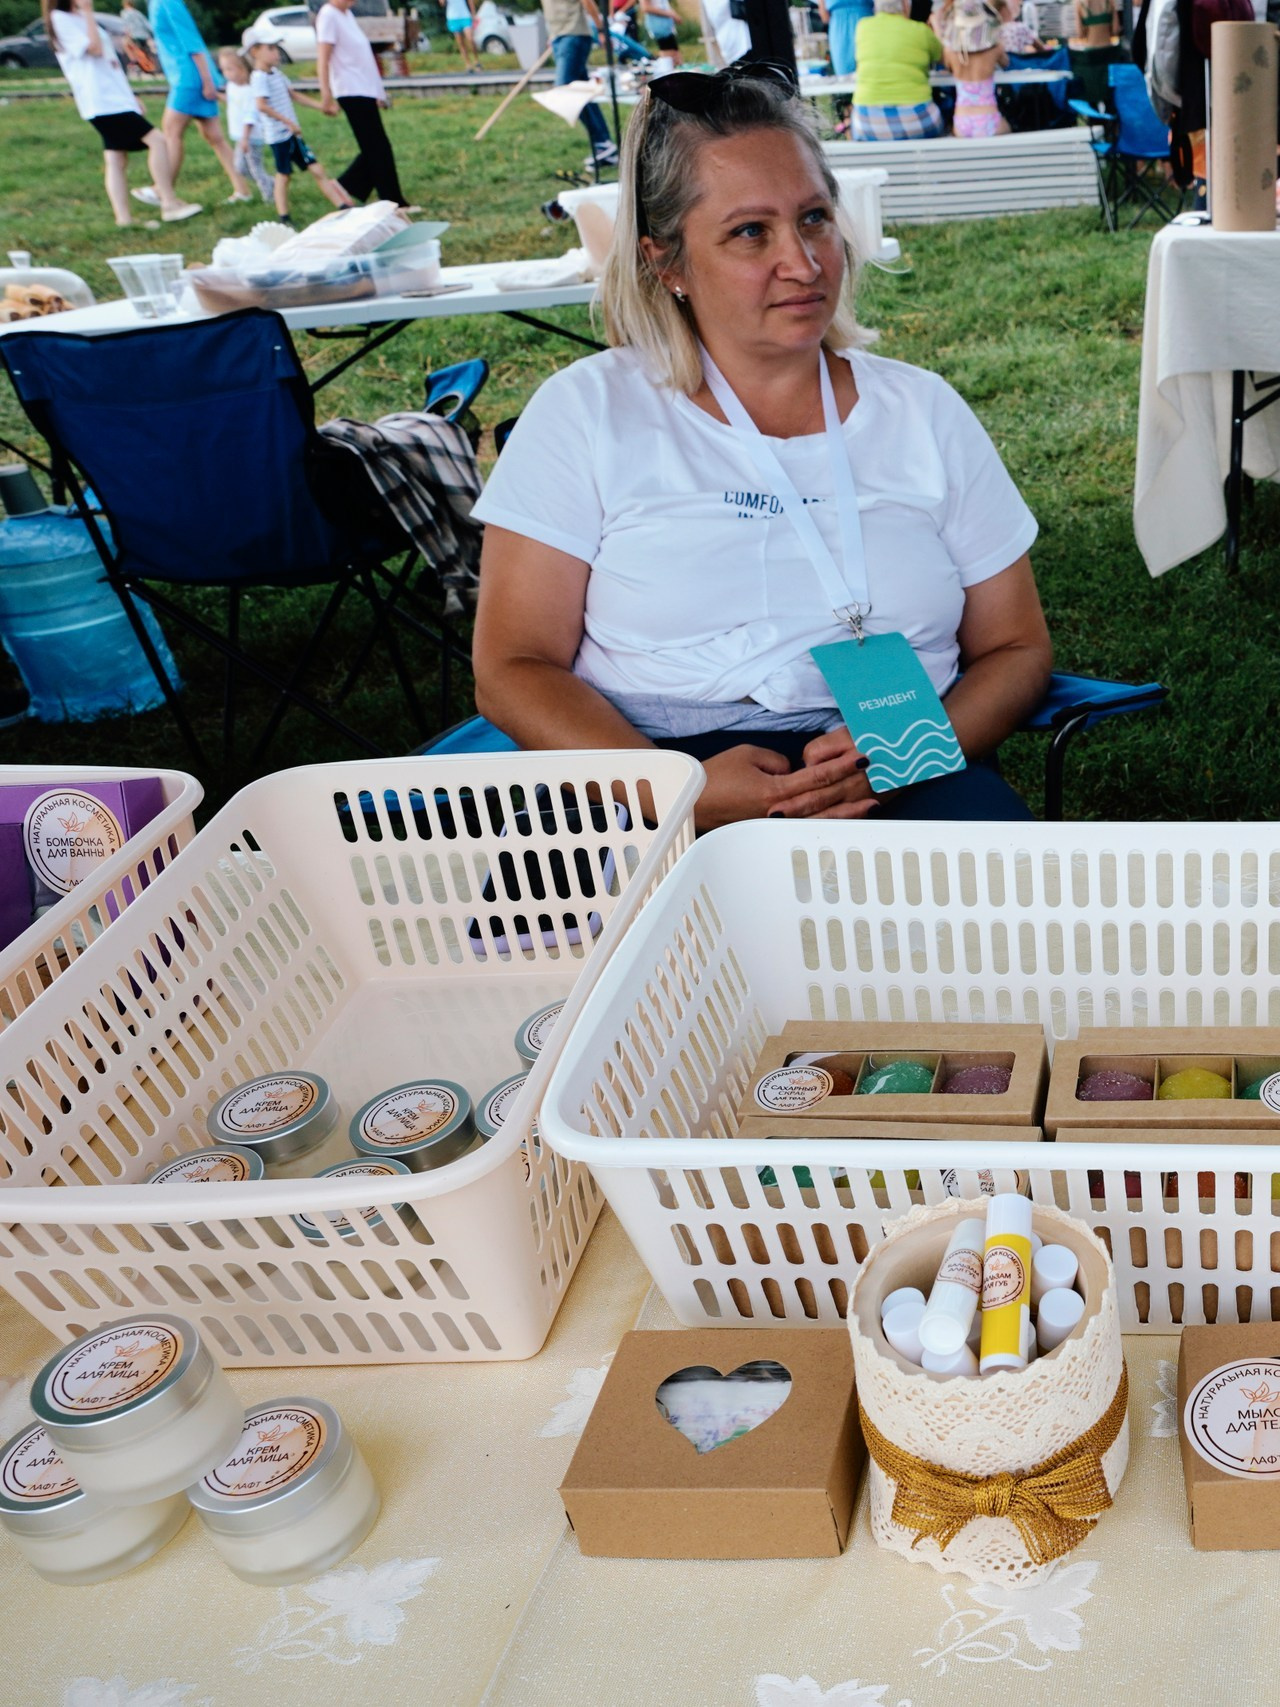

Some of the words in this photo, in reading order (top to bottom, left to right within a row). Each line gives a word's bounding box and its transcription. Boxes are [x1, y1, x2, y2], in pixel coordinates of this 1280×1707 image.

[858, 690, 917, 712] РЕЗИДЕНТ
[33, 798, 71, 844] НАТУРАЛЬНАЯ
[72, 798, 116, 844] КОСМЕТИКА
[46, 837, 104, 847] БОМБОЧКА
[47, 849, 68, 859] ДЛЯ
[70, 849, 105, 858] ВАННЫ
[230, 1080, 284, 1108] НАТУРАЛЬНАЯ
[770, 1084, 817, 1092] САХАРНЫЙ
[391, 1090, 445, 1103] НАТУРАЛЬНАЯ
[238, 1106, 261, 1114] ДЛЯ
[401, 1107, 420, 1121] КРЕМ
[386, 1108, 402, 1120] ДЛЯ
[399, 1118, 417, 1131] ЛИЦА
[371, 1127, 386, 1138] ЛАФТ
[158, 1160, 198, 1184] РАЛЬНАЯ
[67, 1330, 143, 1368] НАТУРАЛЬНАЯ
[144, 1330, 172, 1366] КОСМЕТИКА
[98, 1361, 134, 1370] КРЕМ
[75, 1370, 104, 1381] ДЛЯ
[103, 1370, 140, 1379] ЛИЦА
[1198, 1367, 1261, 1420] НАТУРАЛЬНАЯ
[76, 1396, 106, 1404] ЛАФТ
[283, 1413, 316, 1448] КОСМЕТИКА
[1225, 1420, 1258, 1434] ДЛЯ
[246, 1445, 280, 1456] КРЕМ
[26, 1456, 55, 1468] ДЛЯ
[226, 1457, 253, 1468] ДЛЯ
[254, 1453, 290, 1463] ЛИЦА
[28, 1483, 58, 1491] ЛАФТ
[233, 1481, 262, 1490] ЛАФТ
